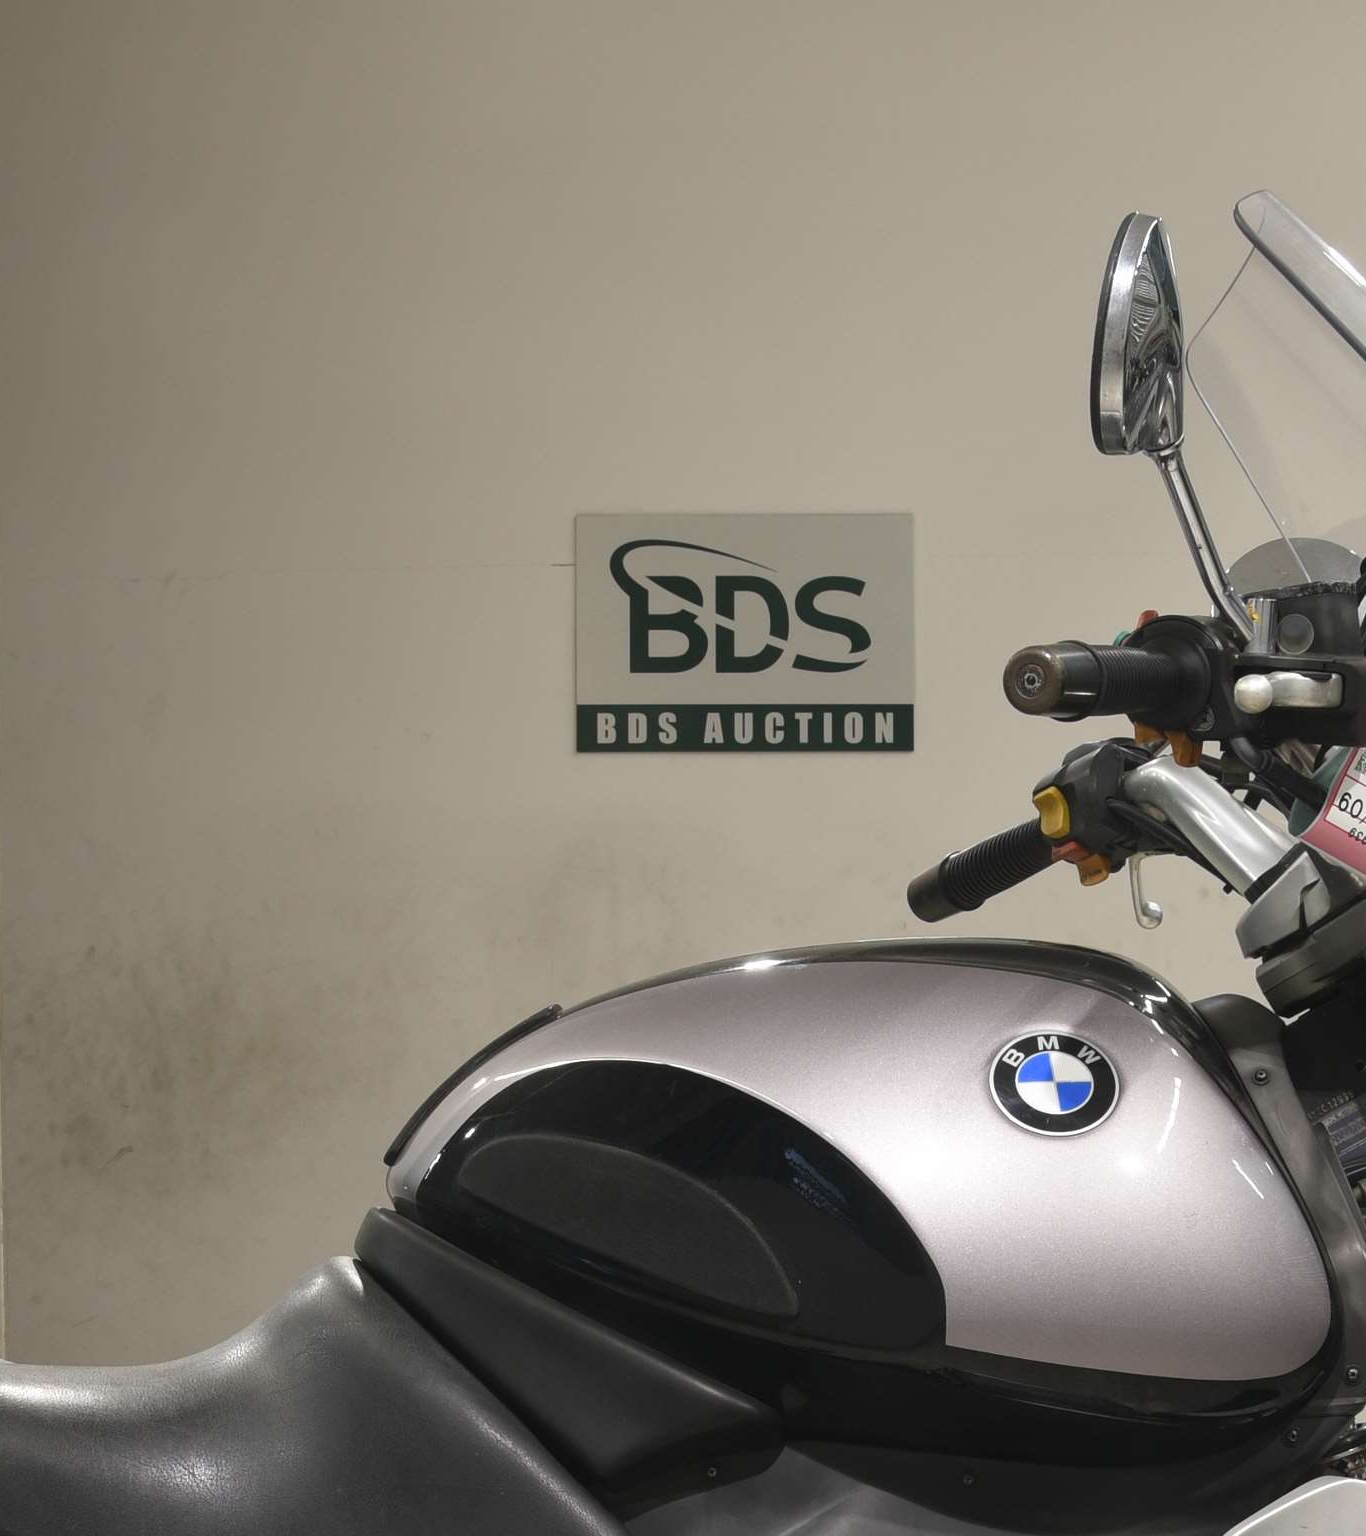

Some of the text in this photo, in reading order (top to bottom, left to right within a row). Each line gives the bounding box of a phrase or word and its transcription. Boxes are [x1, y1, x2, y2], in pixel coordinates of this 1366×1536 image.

[610, 539, 872, 674] BDS
[596, 711, 895, 744] BDS AUCTION
[1002, 1035, 1102, 1068] BMW
